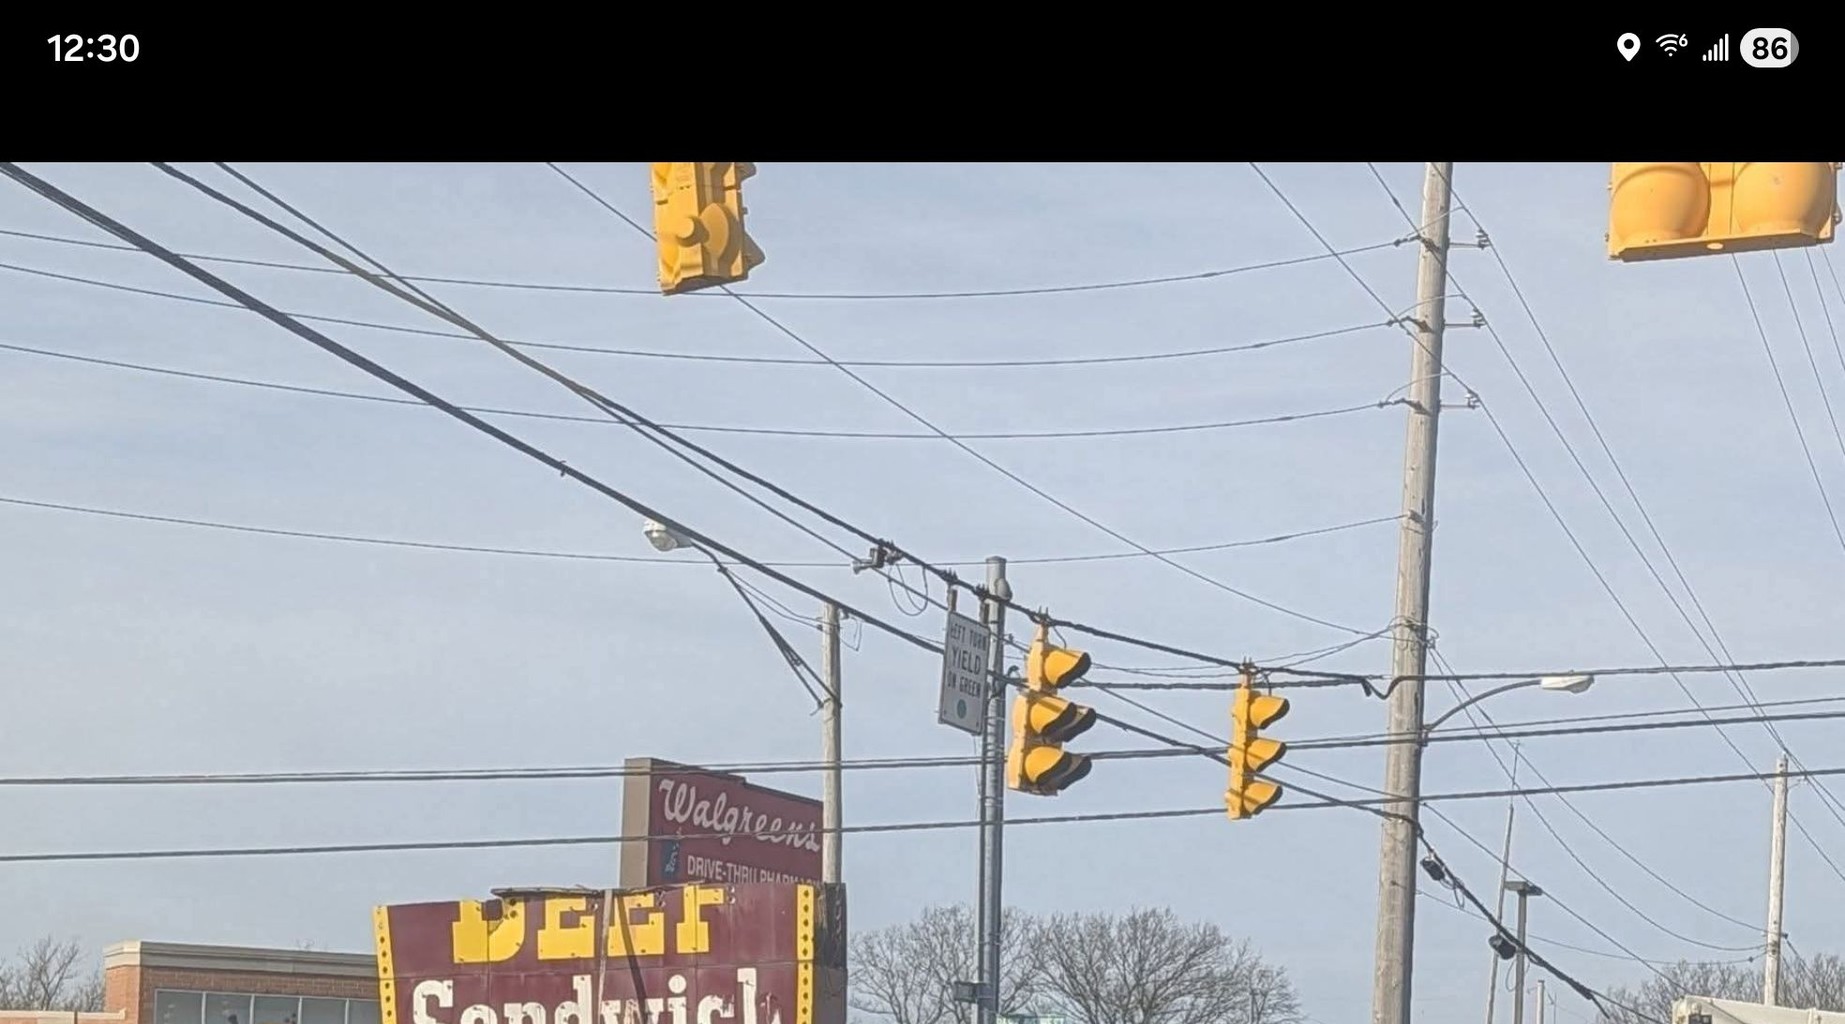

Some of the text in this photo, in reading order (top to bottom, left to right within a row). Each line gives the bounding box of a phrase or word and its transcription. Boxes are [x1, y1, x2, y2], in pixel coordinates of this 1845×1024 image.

[970, 629, 987, 651] TURN
[951, 646, 981, 676] YIELD
[946, 670, 981, 698] ON GREEN
[659, 778, 820, 852] Walgreens
[687, 855, 758, 884] DRIVE-THRU
